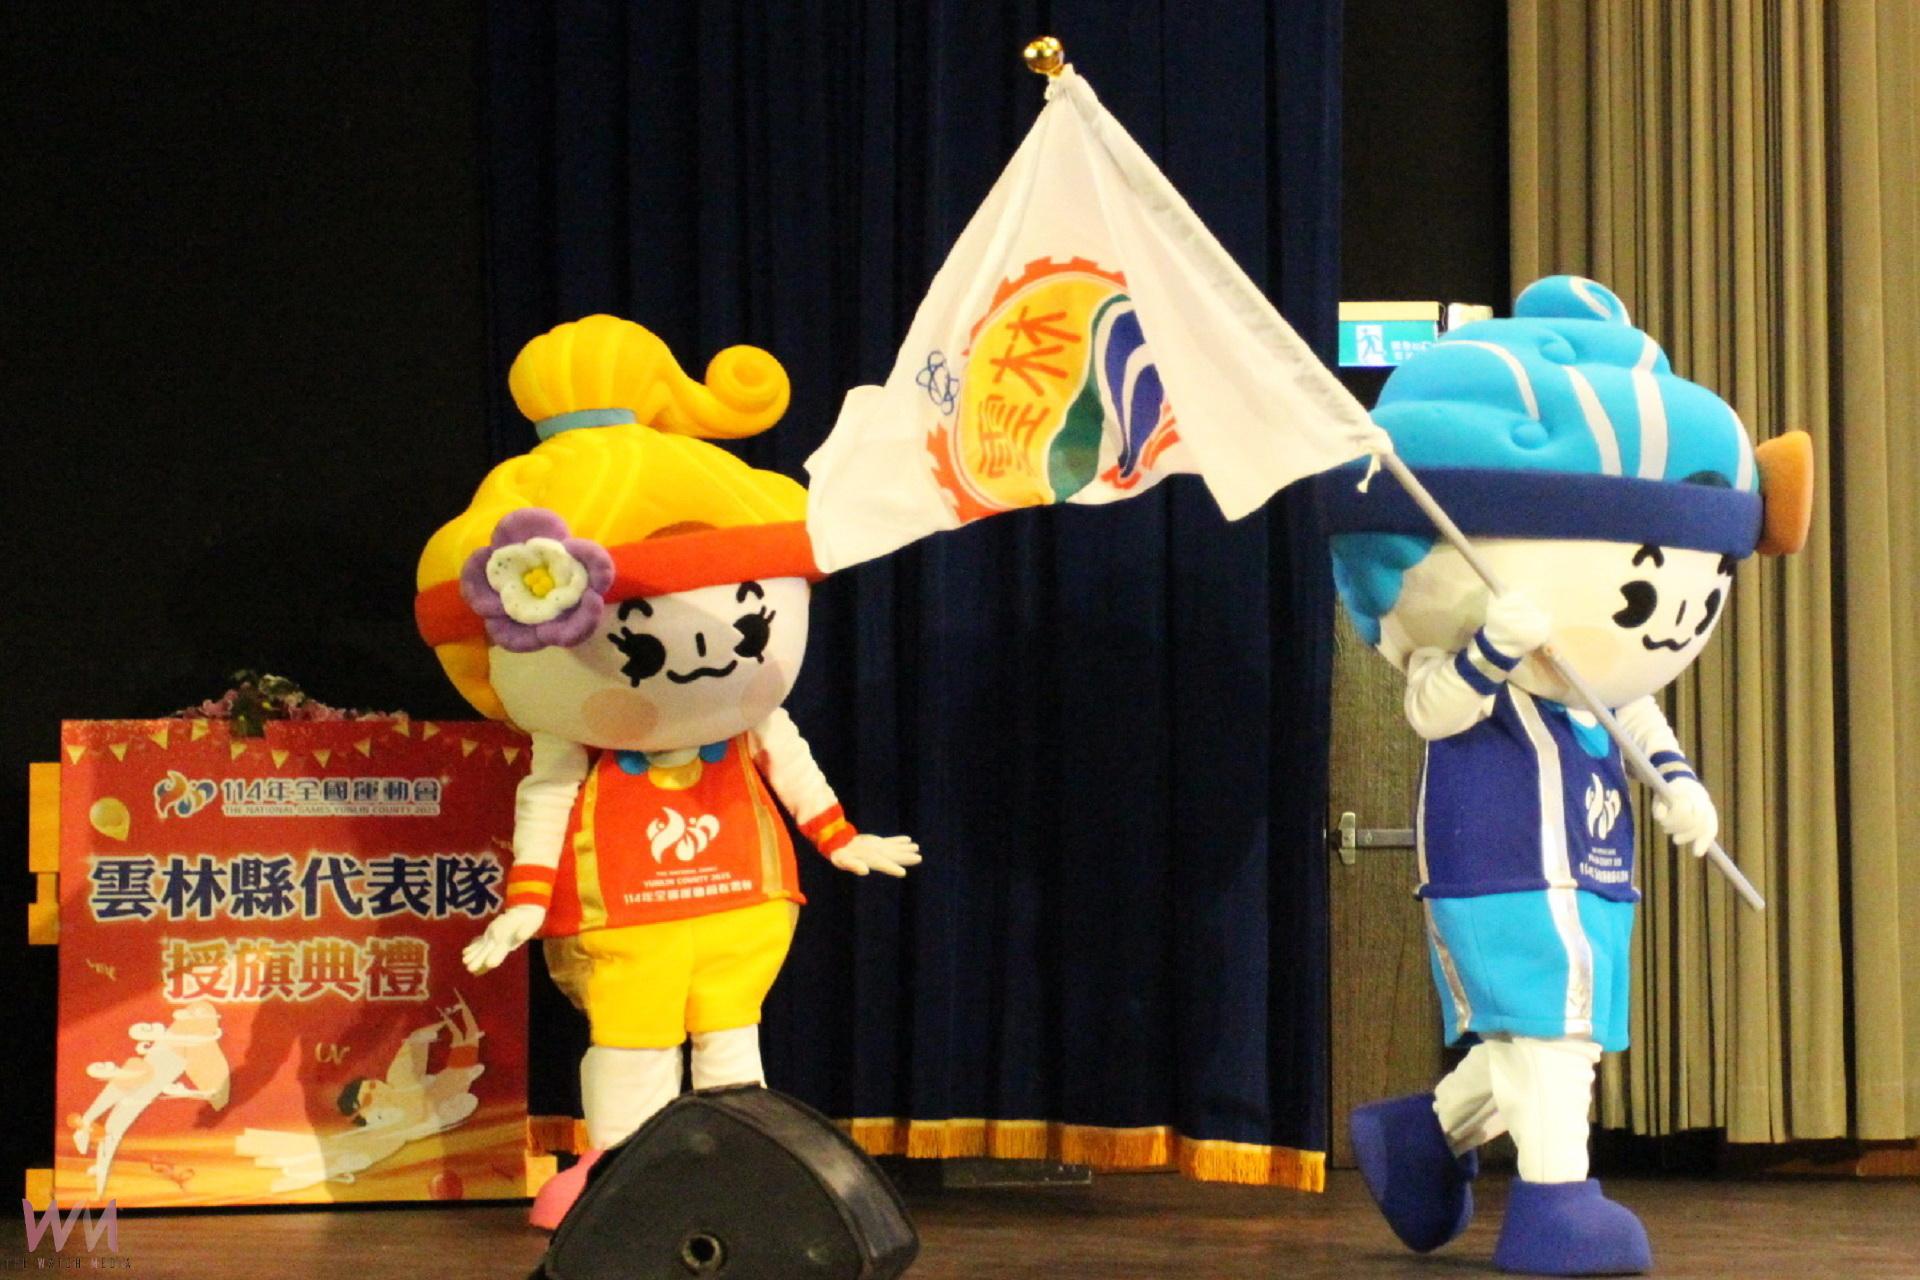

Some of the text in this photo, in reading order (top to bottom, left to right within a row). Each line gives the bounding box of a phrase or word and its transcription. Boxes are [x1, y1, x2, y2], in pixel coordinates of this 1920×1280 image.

[223, 779, 440, 802] 114年全國運動會
[89, 854, 503, 920] 雲林縣代表隊
[163, 938, 431, 1001] 授旗典禮
